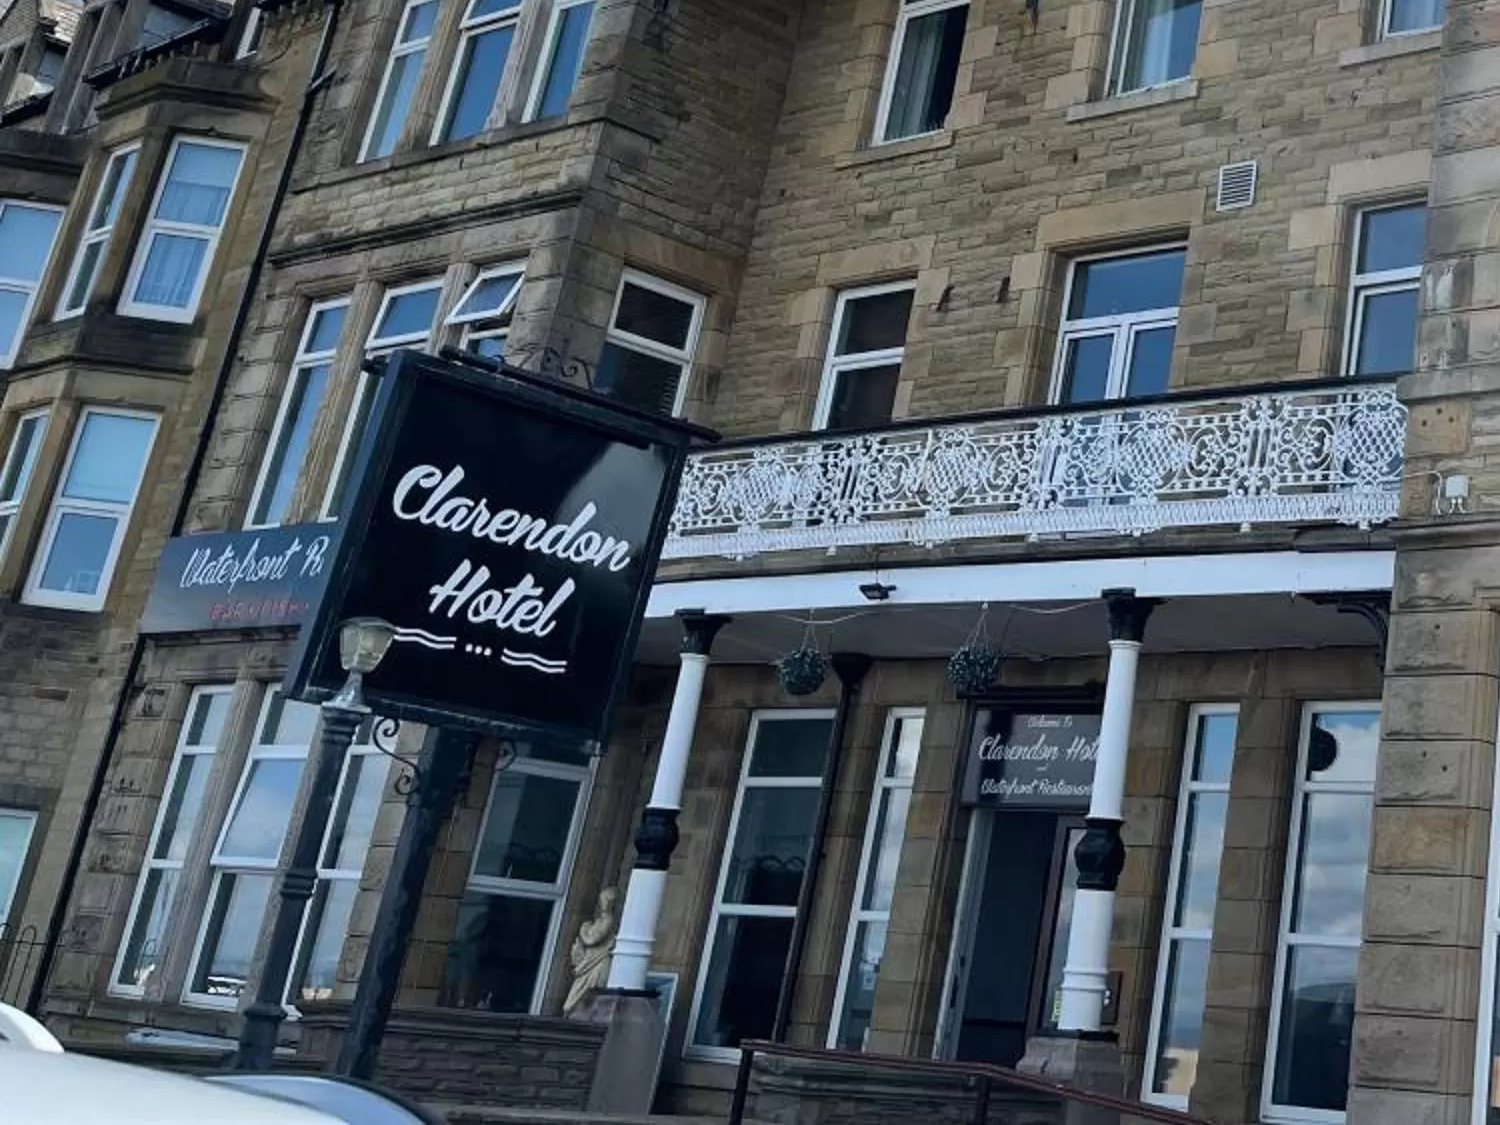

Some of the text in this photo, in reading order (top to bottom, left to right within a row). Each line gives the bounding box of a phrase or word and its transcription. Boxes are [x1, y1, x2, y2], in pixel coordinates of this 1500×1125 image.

[393, 464, 631, 572] Clarendon
[179, 537, 302, 594] Waterfront
[429, 559, 575, 637] Hotel
[978, 733, 1059, 762] Clarendon
